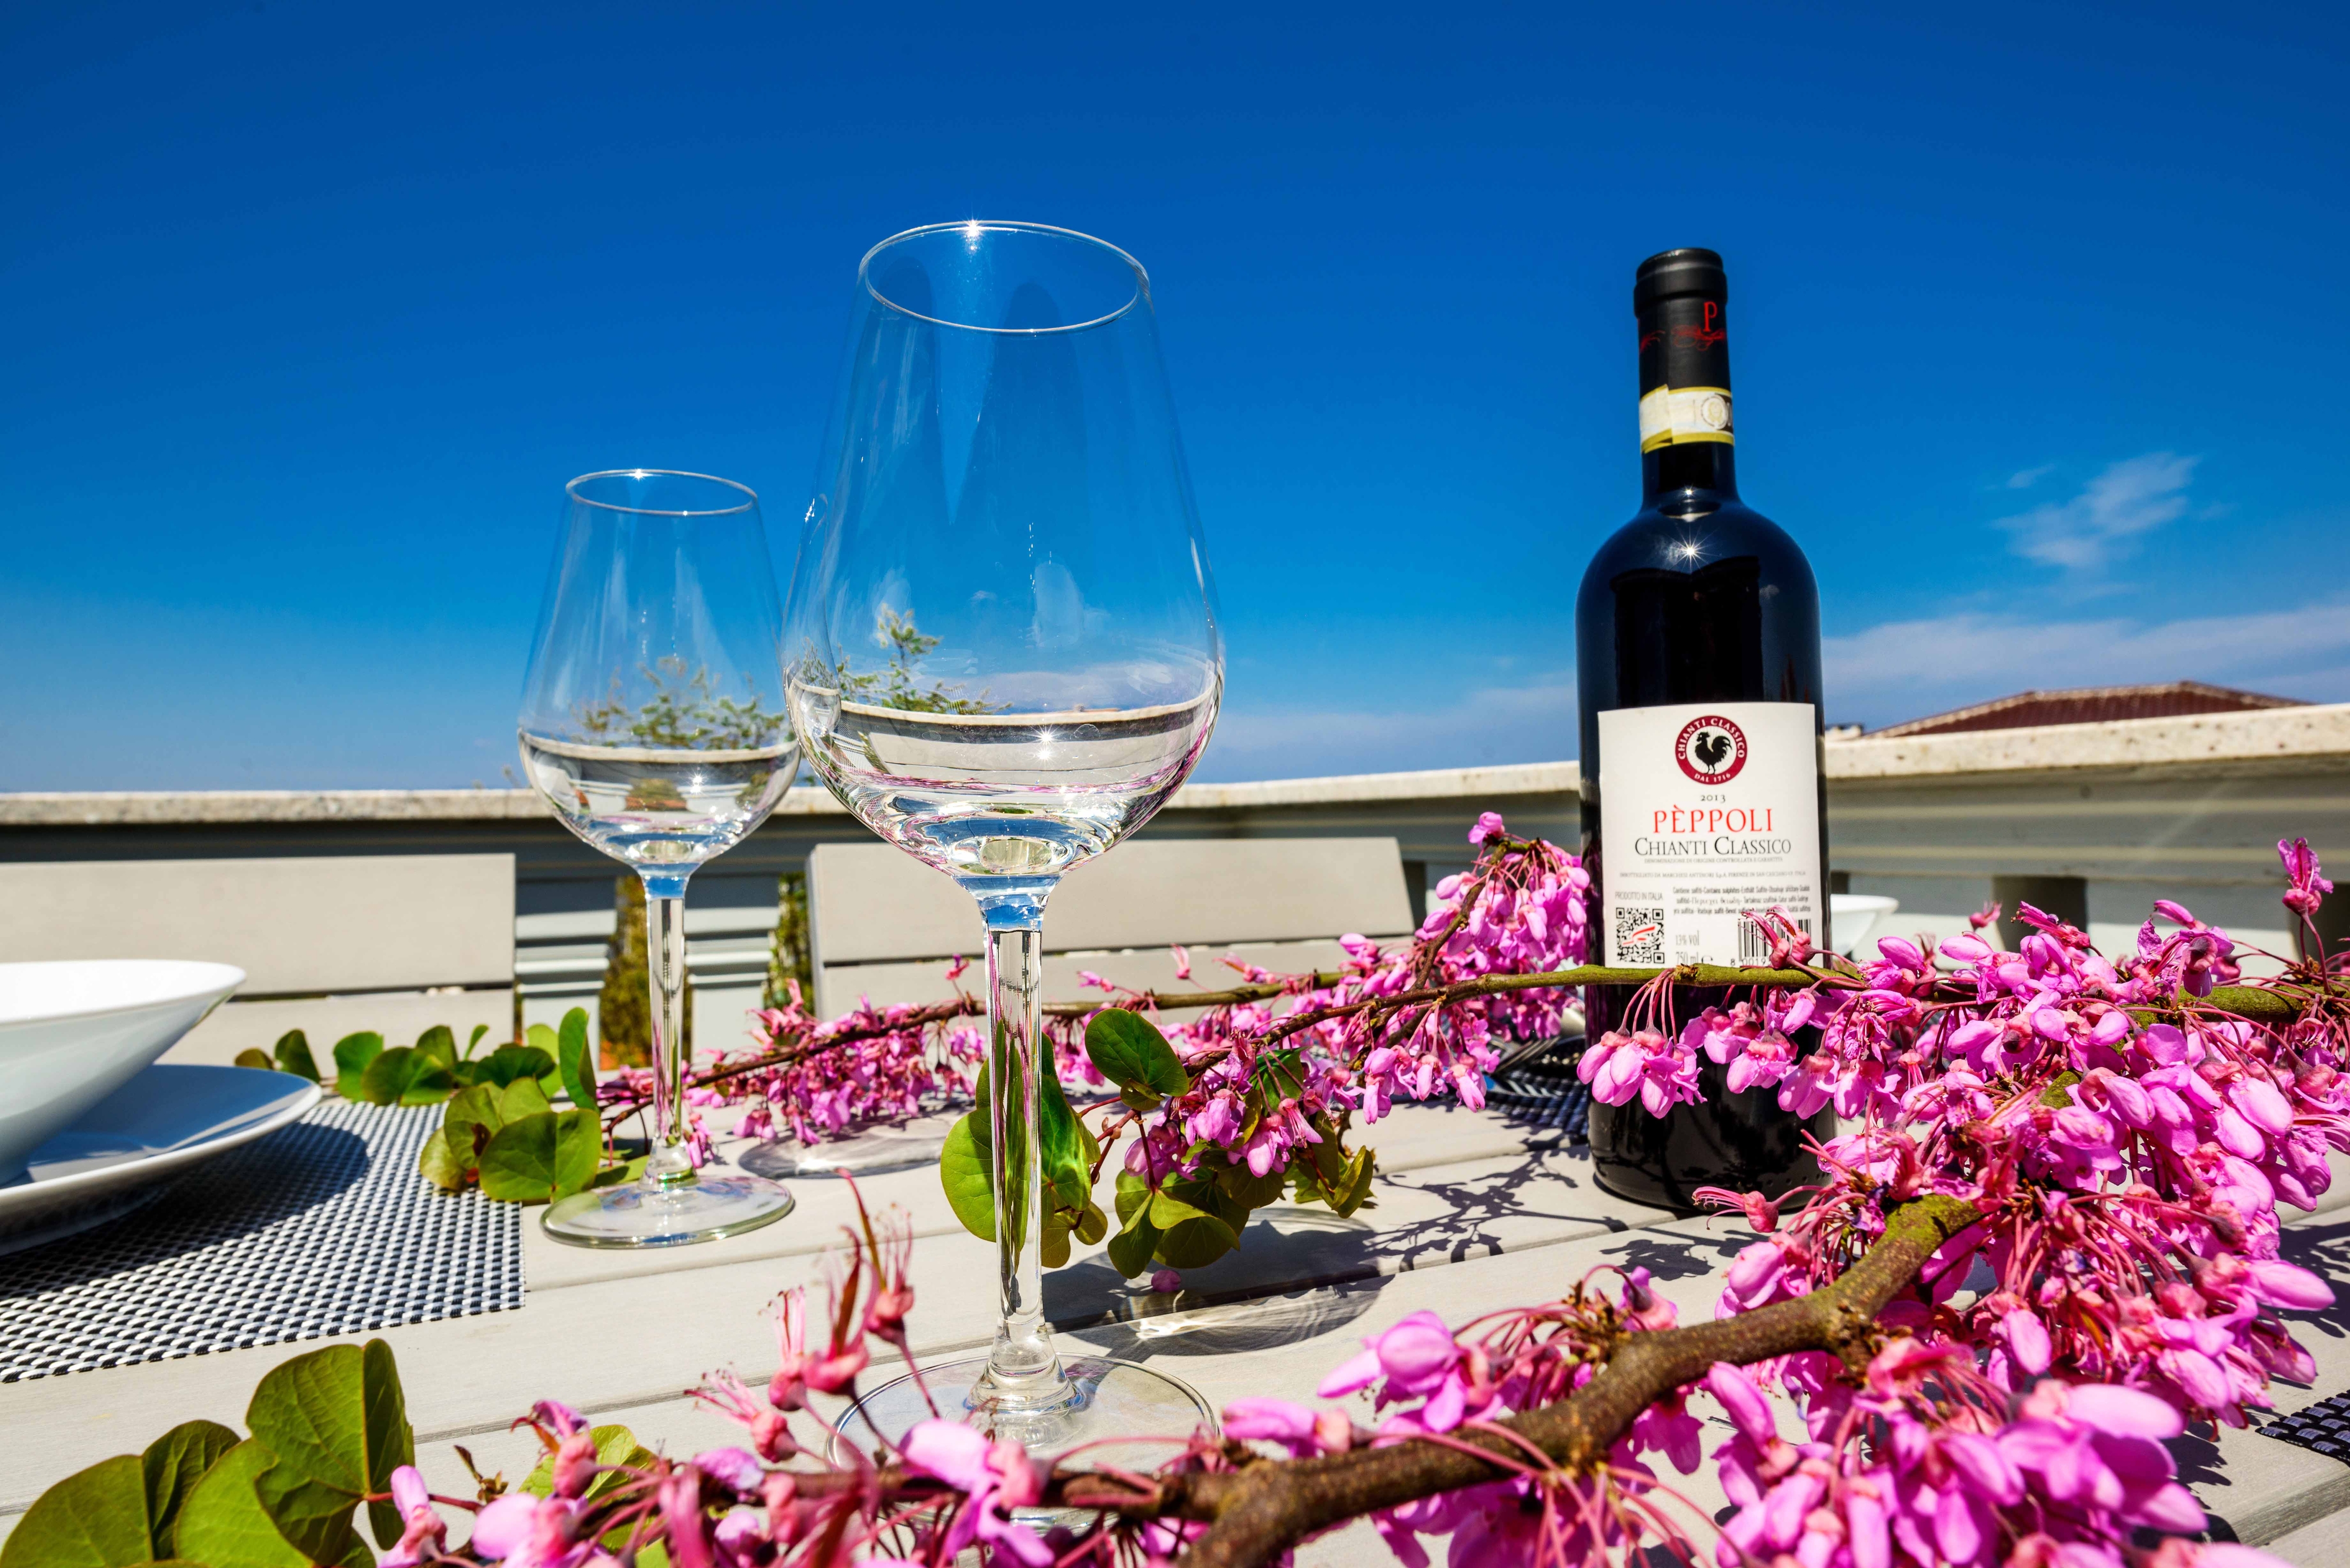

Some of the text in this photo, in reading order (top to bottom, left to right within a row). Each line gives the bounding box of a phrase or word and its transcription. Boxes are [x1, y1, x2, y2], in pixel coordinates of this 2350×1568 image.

[1703, 301, 1718, 332] P
[1678, 718, 1745, 760] CHIANTI CLASSICO
[1694, 773, 1731, 783] DAL 1716
[1700, 794, 1726, 804] 2013
[1653, 804, 1772, 833] PÈPPOLI
[1635, 836, 1791, 855] CHIANTI CLASSICO
[1614, 891, 1664, 901] PRODOTTO IN ITALIA
